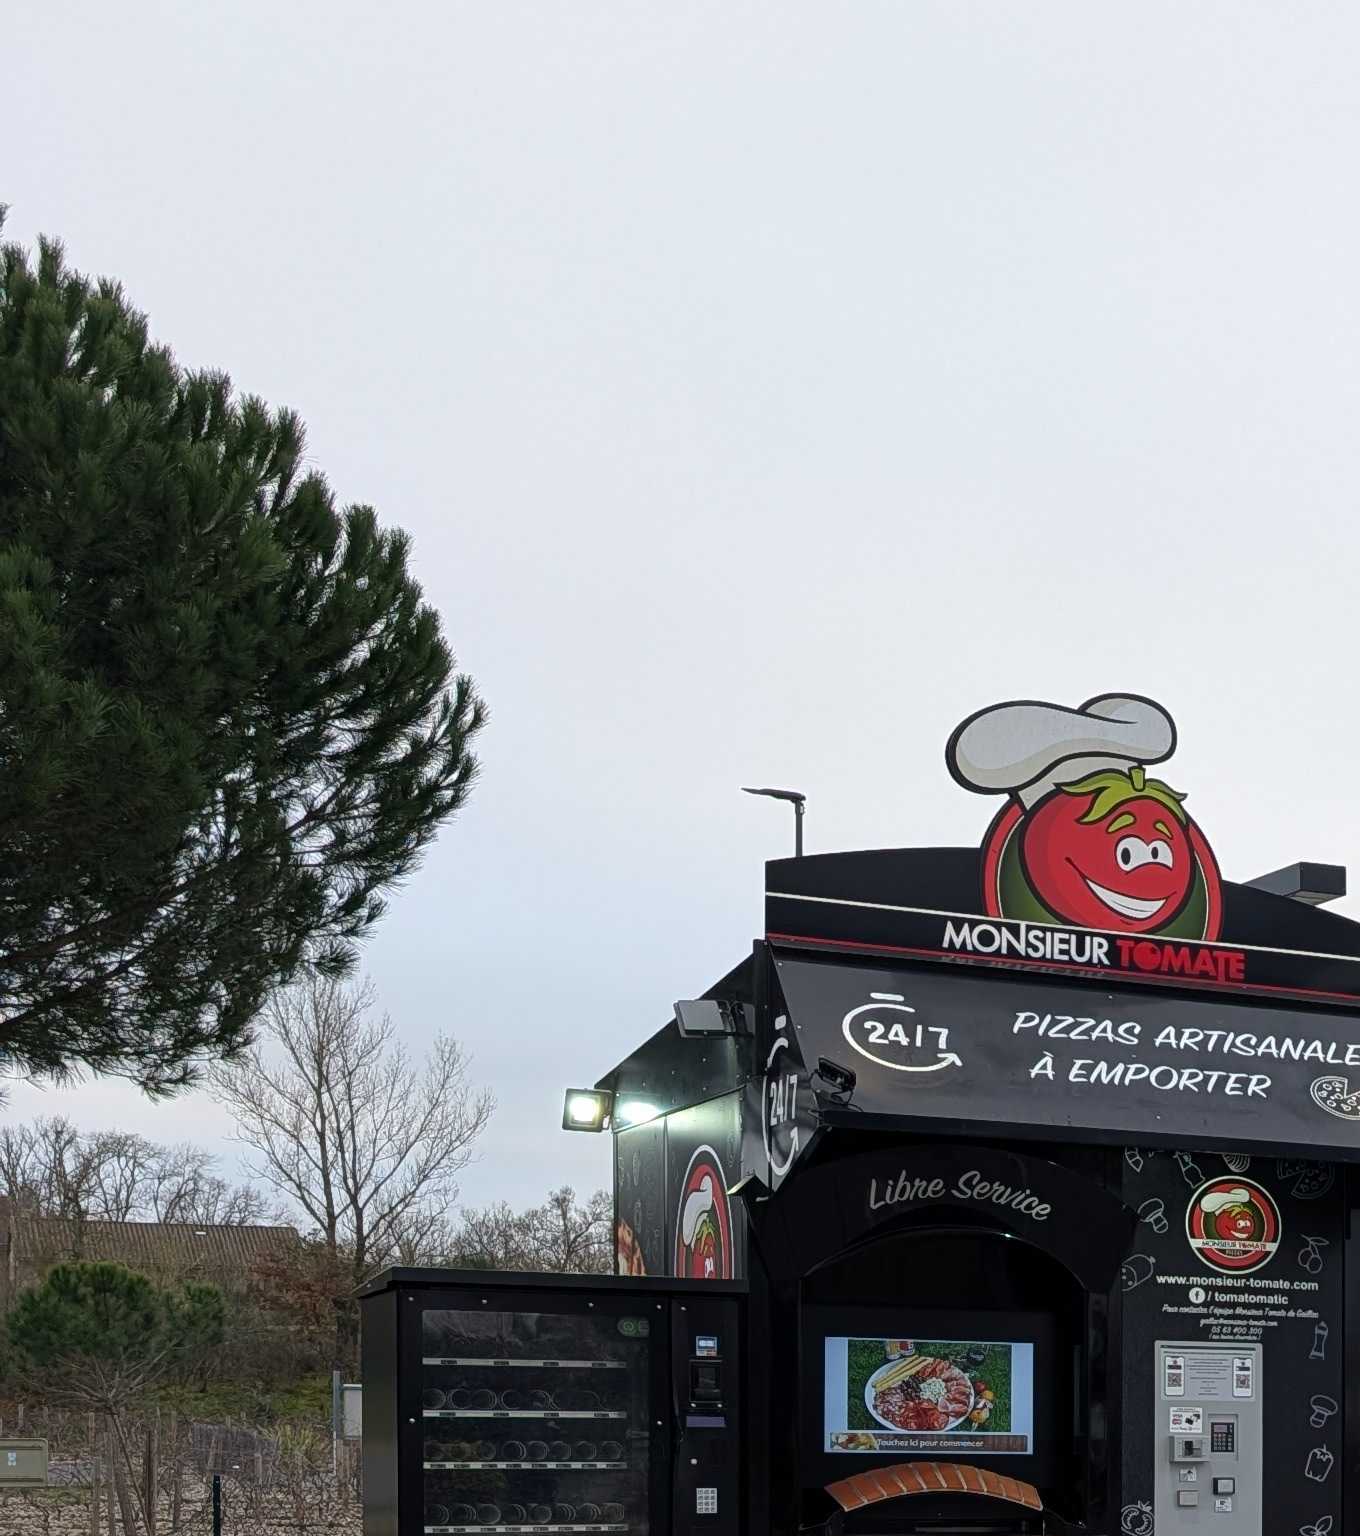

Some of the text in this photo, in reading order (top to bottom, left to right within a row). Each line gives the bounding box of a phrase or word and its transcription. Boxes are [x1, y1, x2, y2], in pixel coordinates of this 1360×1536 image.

[942, 920, 1245, 983] MONSIEUR TOMATE
[1012, 1011, 1141, 1046] PIZZAS
[1030, 1051, 1272, 1099] À EMPORTER
[769, 1074, 798, 1127] 24/7
[869, 1171, 1051, 1222] Libre Service
[1156, 1275, 1319, 1291] www.monsieur-tomate.com
[1214, 1291, 1289, 1305] tomatomatic
